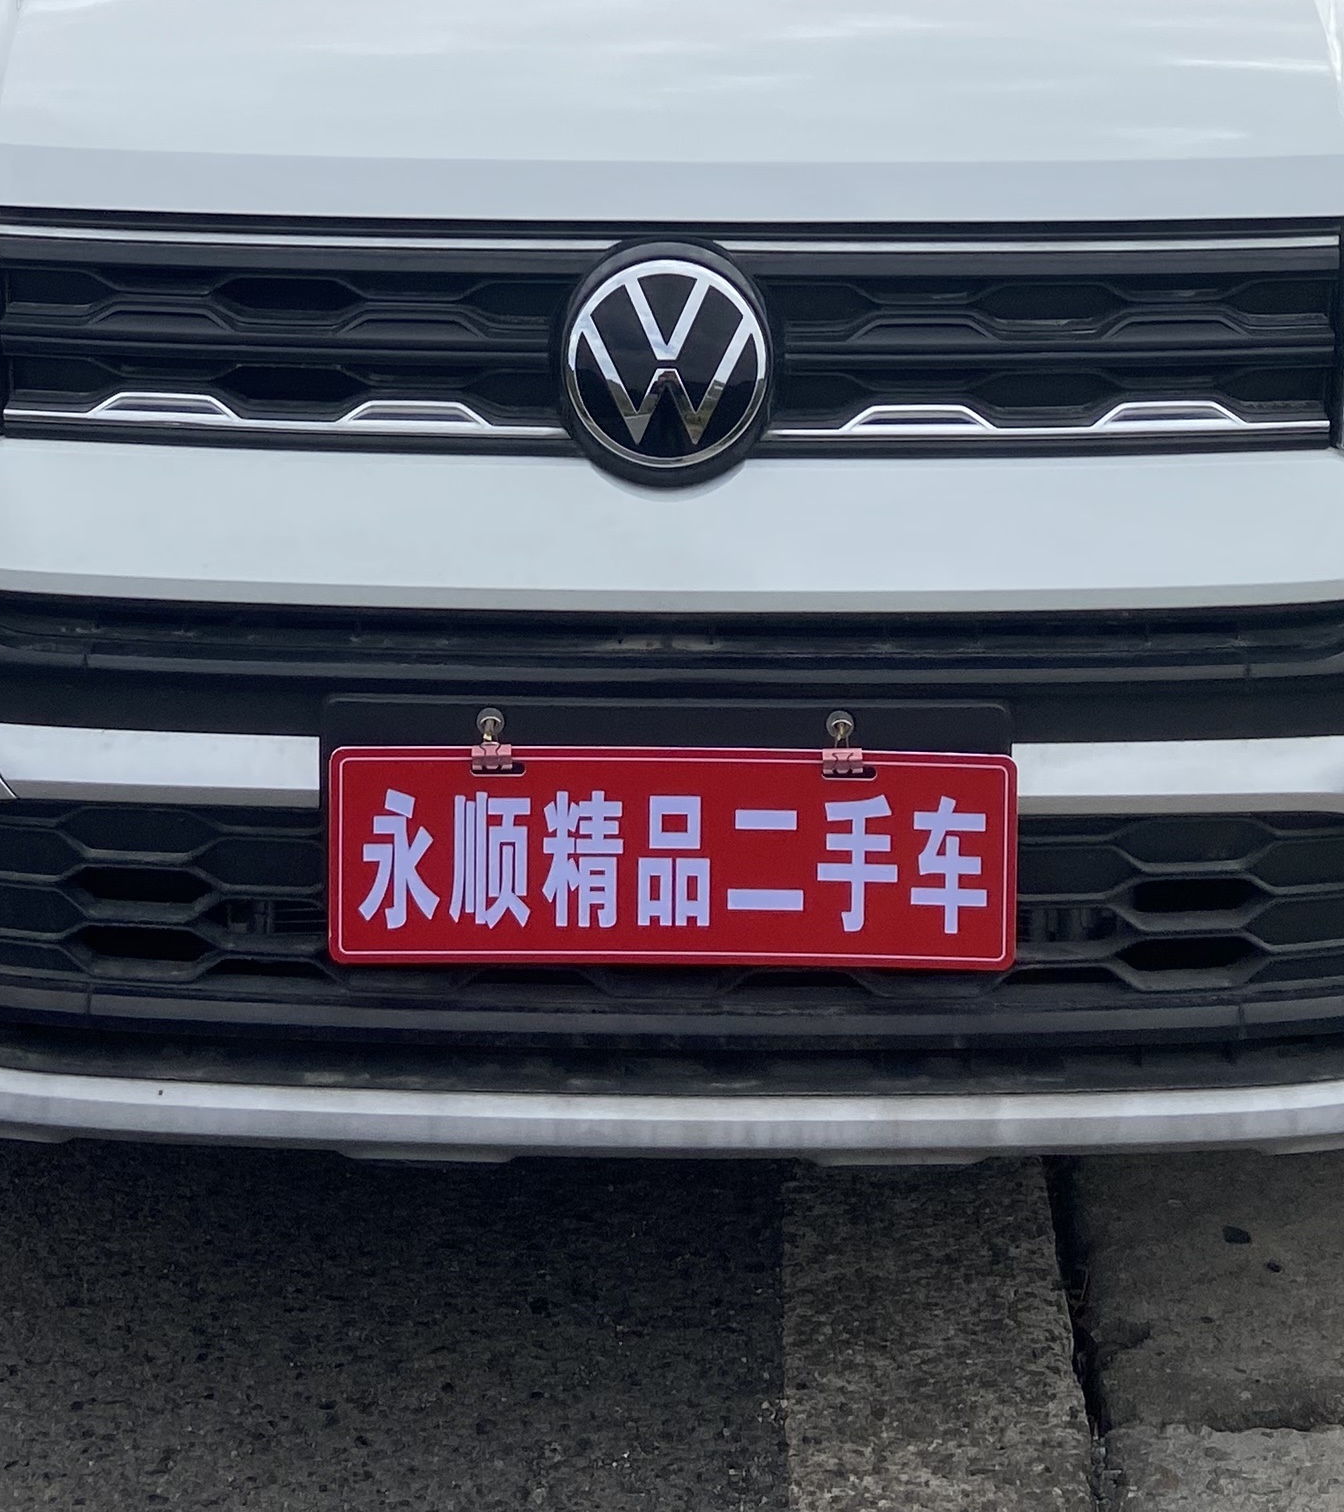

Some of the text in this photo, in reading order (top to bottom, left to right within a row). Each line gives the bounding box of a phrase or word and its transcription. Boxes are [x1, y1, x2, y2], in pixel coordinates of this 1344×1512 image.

[358, 789, 988, 935] 永顺精品二手车
